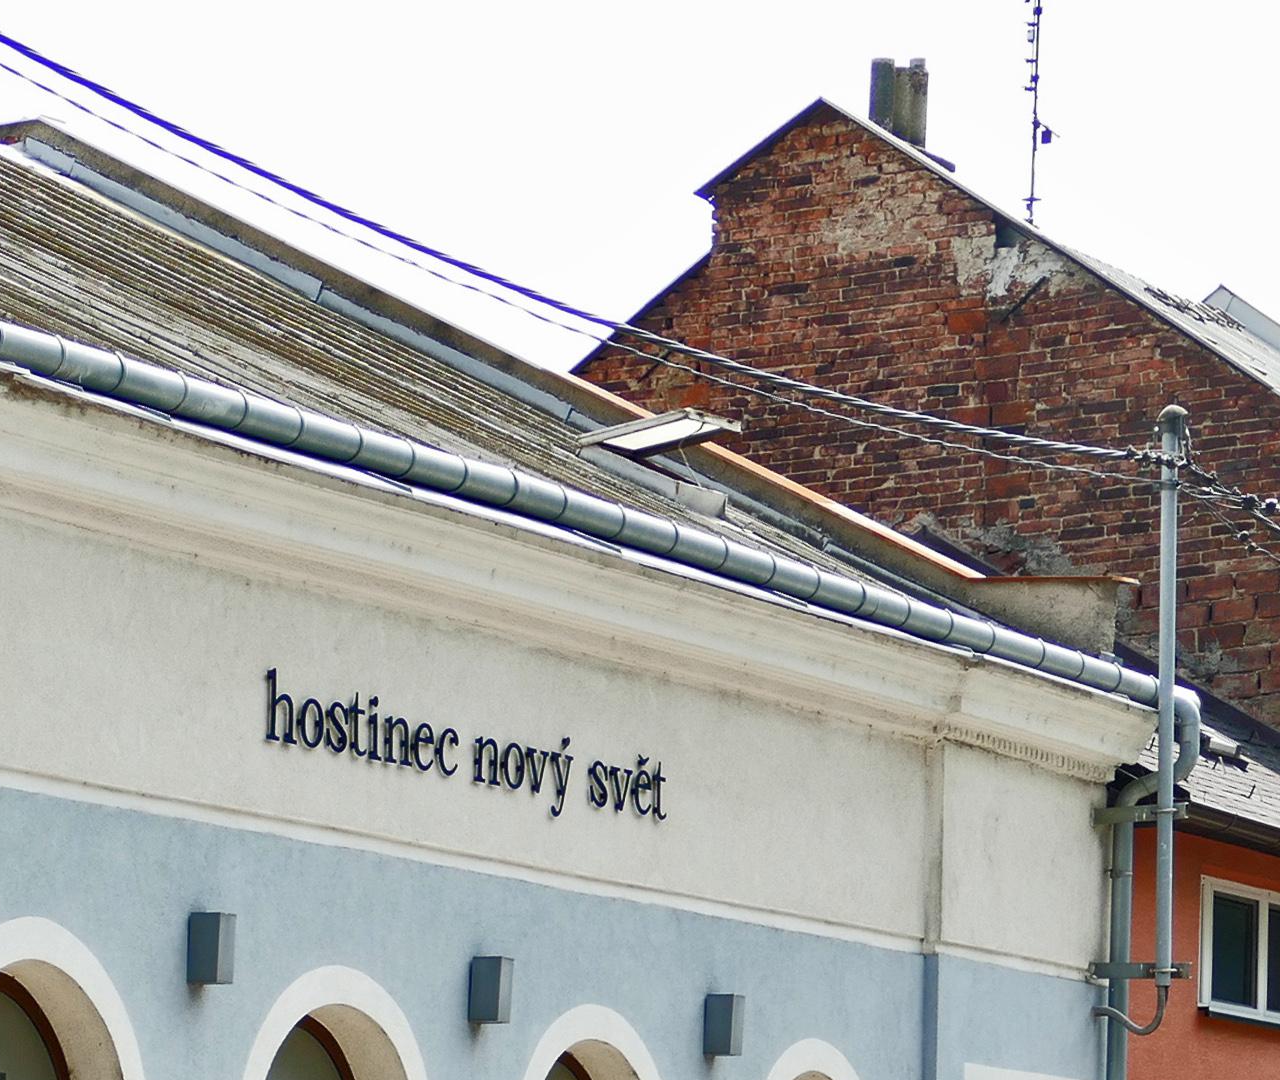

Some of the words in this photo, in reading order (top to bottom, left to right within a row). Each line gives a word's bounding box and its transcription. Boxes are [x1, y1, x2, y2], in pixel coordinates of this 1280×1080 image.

[265, 667, 459, 777] hostinec
[473, 736, 574, 818] nový
[587, 754, 668, 821] svět
